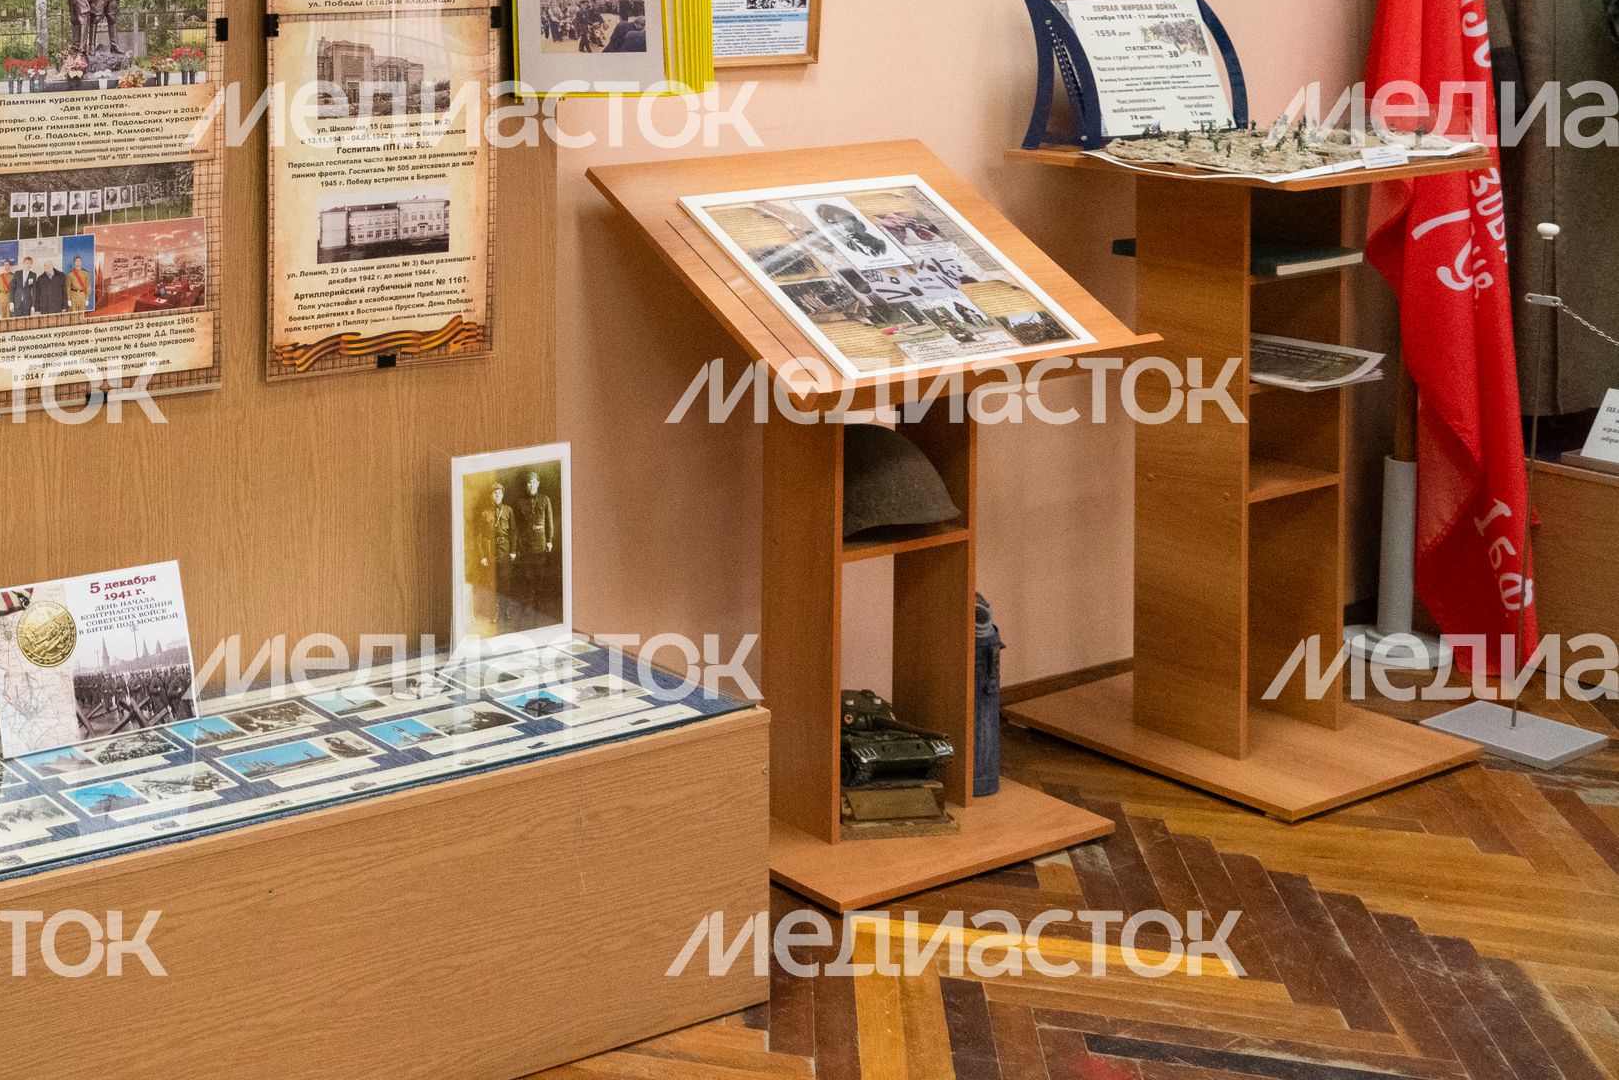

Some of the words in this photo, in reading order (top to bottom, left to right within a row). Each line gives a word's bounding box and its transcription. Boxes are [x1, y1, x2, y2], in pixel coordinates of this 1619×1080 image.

[89, 580, 100, 595] 5
[104, 573, 156, 592] декабря
[95, 602, 118, 611] ДЕНЬ
[120, 596, 154, 607] НАЧАЛА
[104, 589, 131, 602] 1941
[135, 587, 145, 595] г.
[80, 599, 172, 620] КОНТРНАСТУПЛЕНИЯ
[85, 612, 136, 627] СОВЕТСКИХ
[138, 607, 166, 617] ВОЙСК
[86, 623, 114, 634] БИТВЕ
[116, 619, 134, 629] ПОД
[136, 612, 178, 625] МОСКВОЙ
